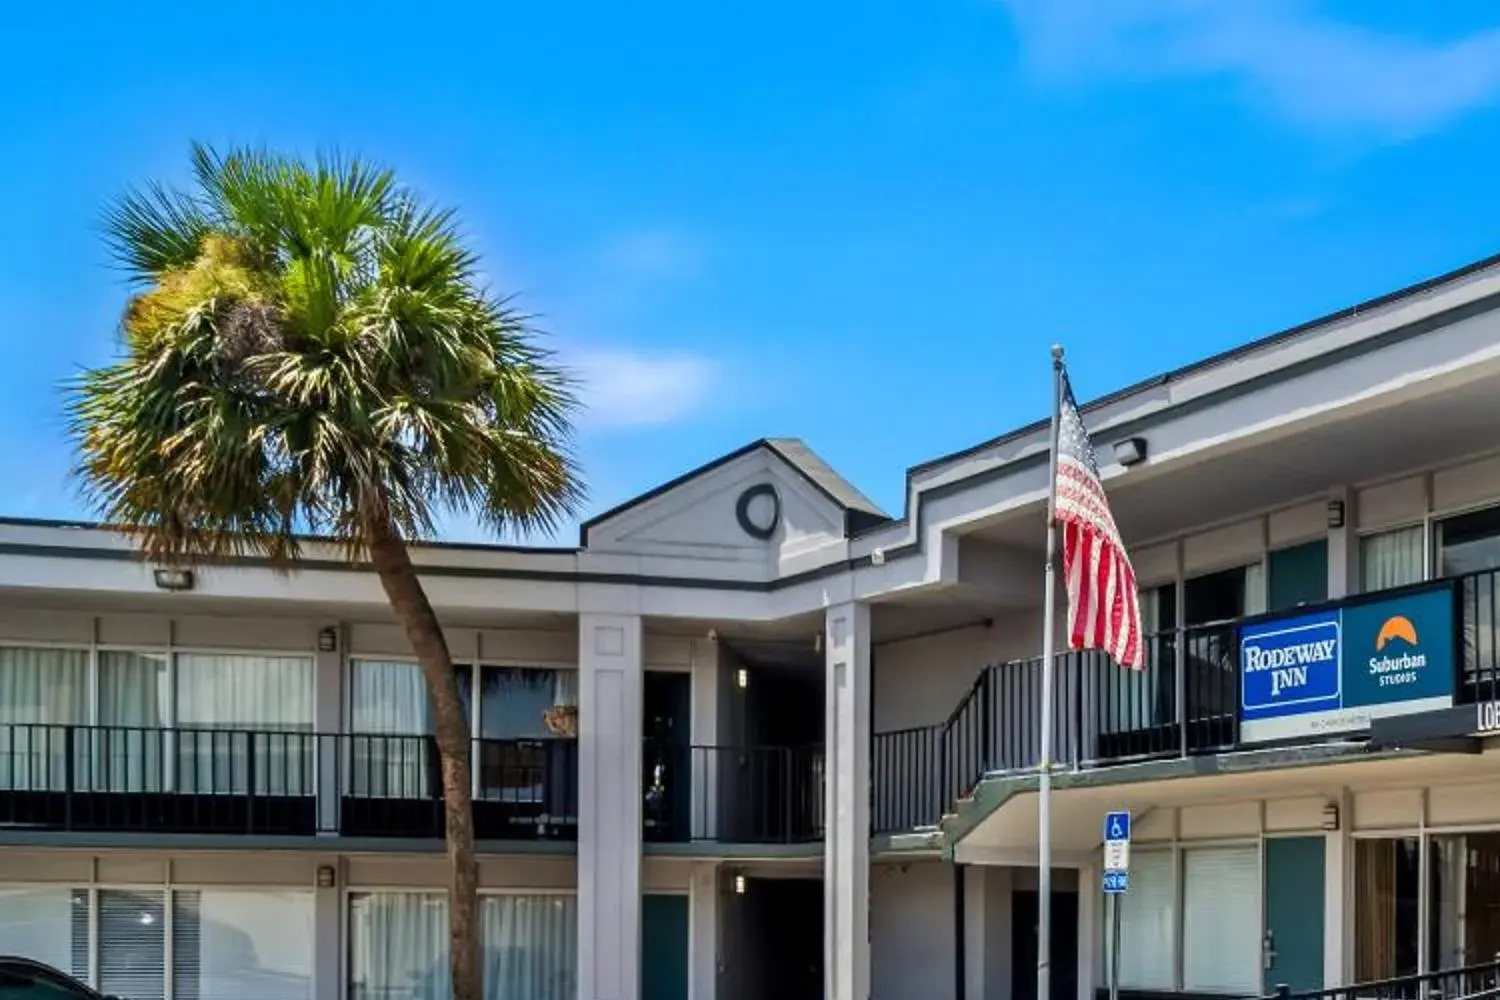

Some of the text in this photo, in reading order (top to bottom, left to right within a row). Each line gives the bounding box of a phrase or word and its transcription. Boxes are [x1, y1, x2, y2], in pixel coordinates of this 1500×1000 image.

[1245, 639, 1336, 673] RODEWAY
[1369, 651, 1426, 675] Suburban
[1271, 666, 1308, 696] INN
[1379, 671, 1417, 687] STUDIOS
